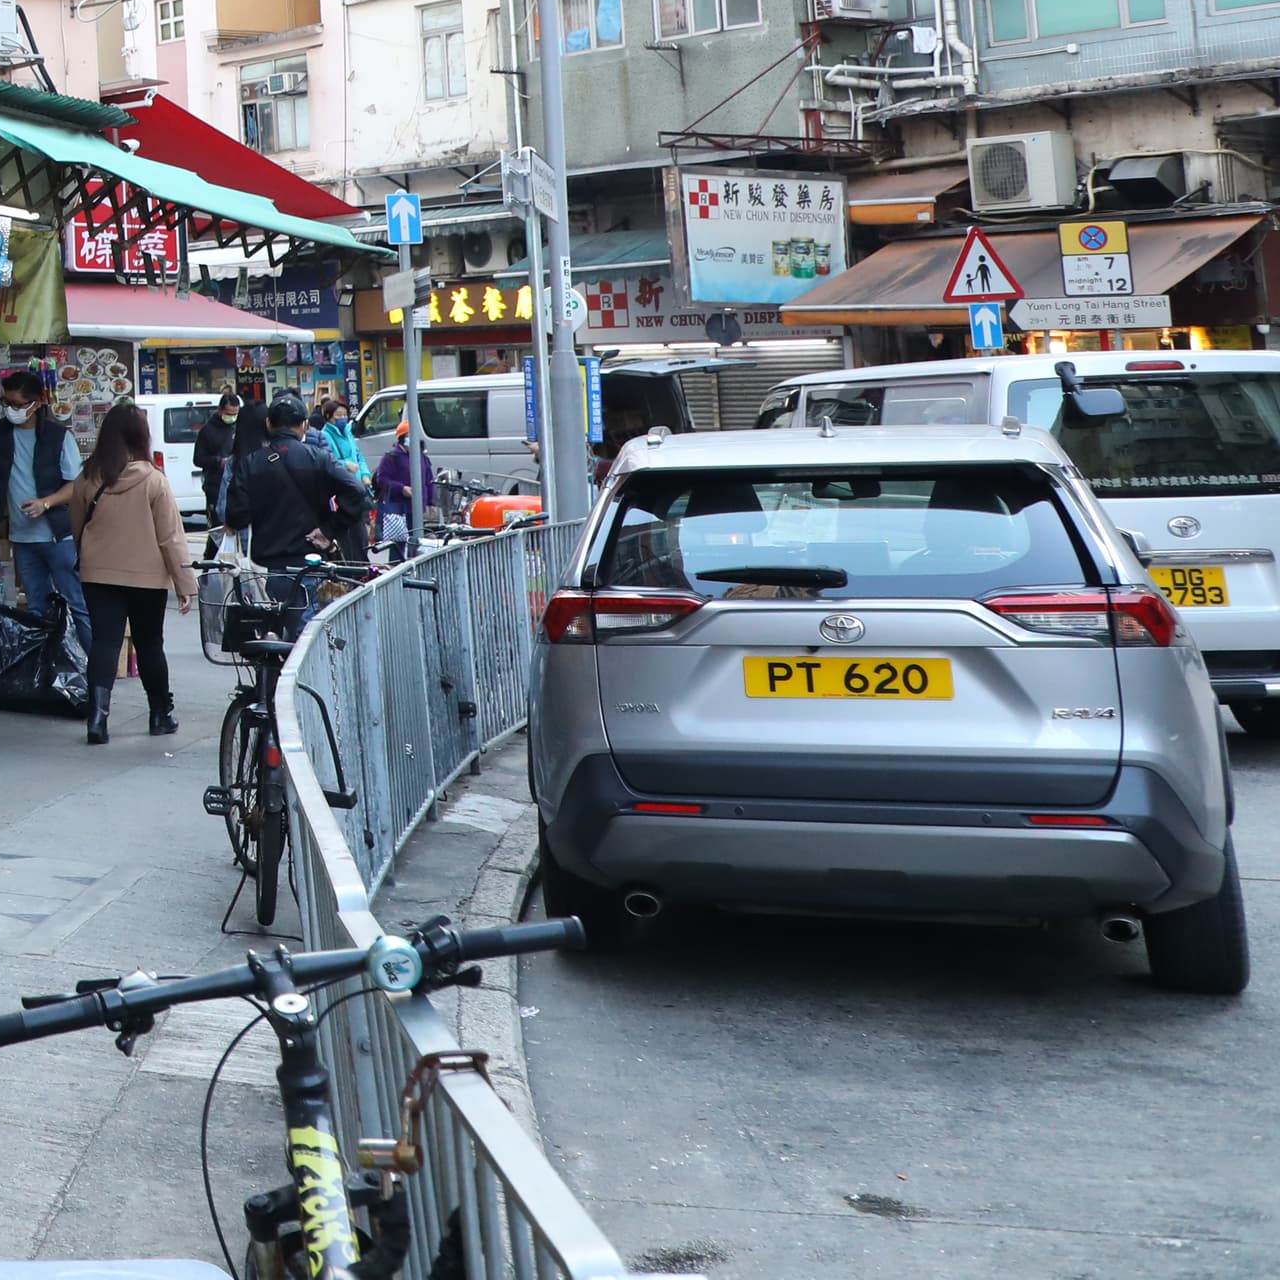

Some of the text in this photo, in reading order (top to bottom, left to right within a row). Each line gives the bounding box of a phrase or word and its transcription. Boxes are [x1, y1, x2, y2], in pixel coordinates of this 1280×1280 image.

[723, 181, 835, 211] 新駿發藥房
[723, 209, 837, 225] NEW CHUN FAT DISPENSARY
[1103, 256, 1115, 270] 7
[1068, 277, 1127, 292] midnight 12
[635, 277, 664, 312] 新
[1026, 298, 1167, 312] Yuen Long Tai Hang Street
[636, 316, 664, 328] NEW
[670, 313, 706, 327] CHUN
[1059, 314, 1136, 326] 元朗泰衡街
[1171, 568, 1205, 587] DG
[1159, 586, 1225, 605] 2793
[767, 661, 930, 696] PT 620
[614, 703, 660, 714] TOYOTA
[1051, 707, 1117, 720] RAV4
